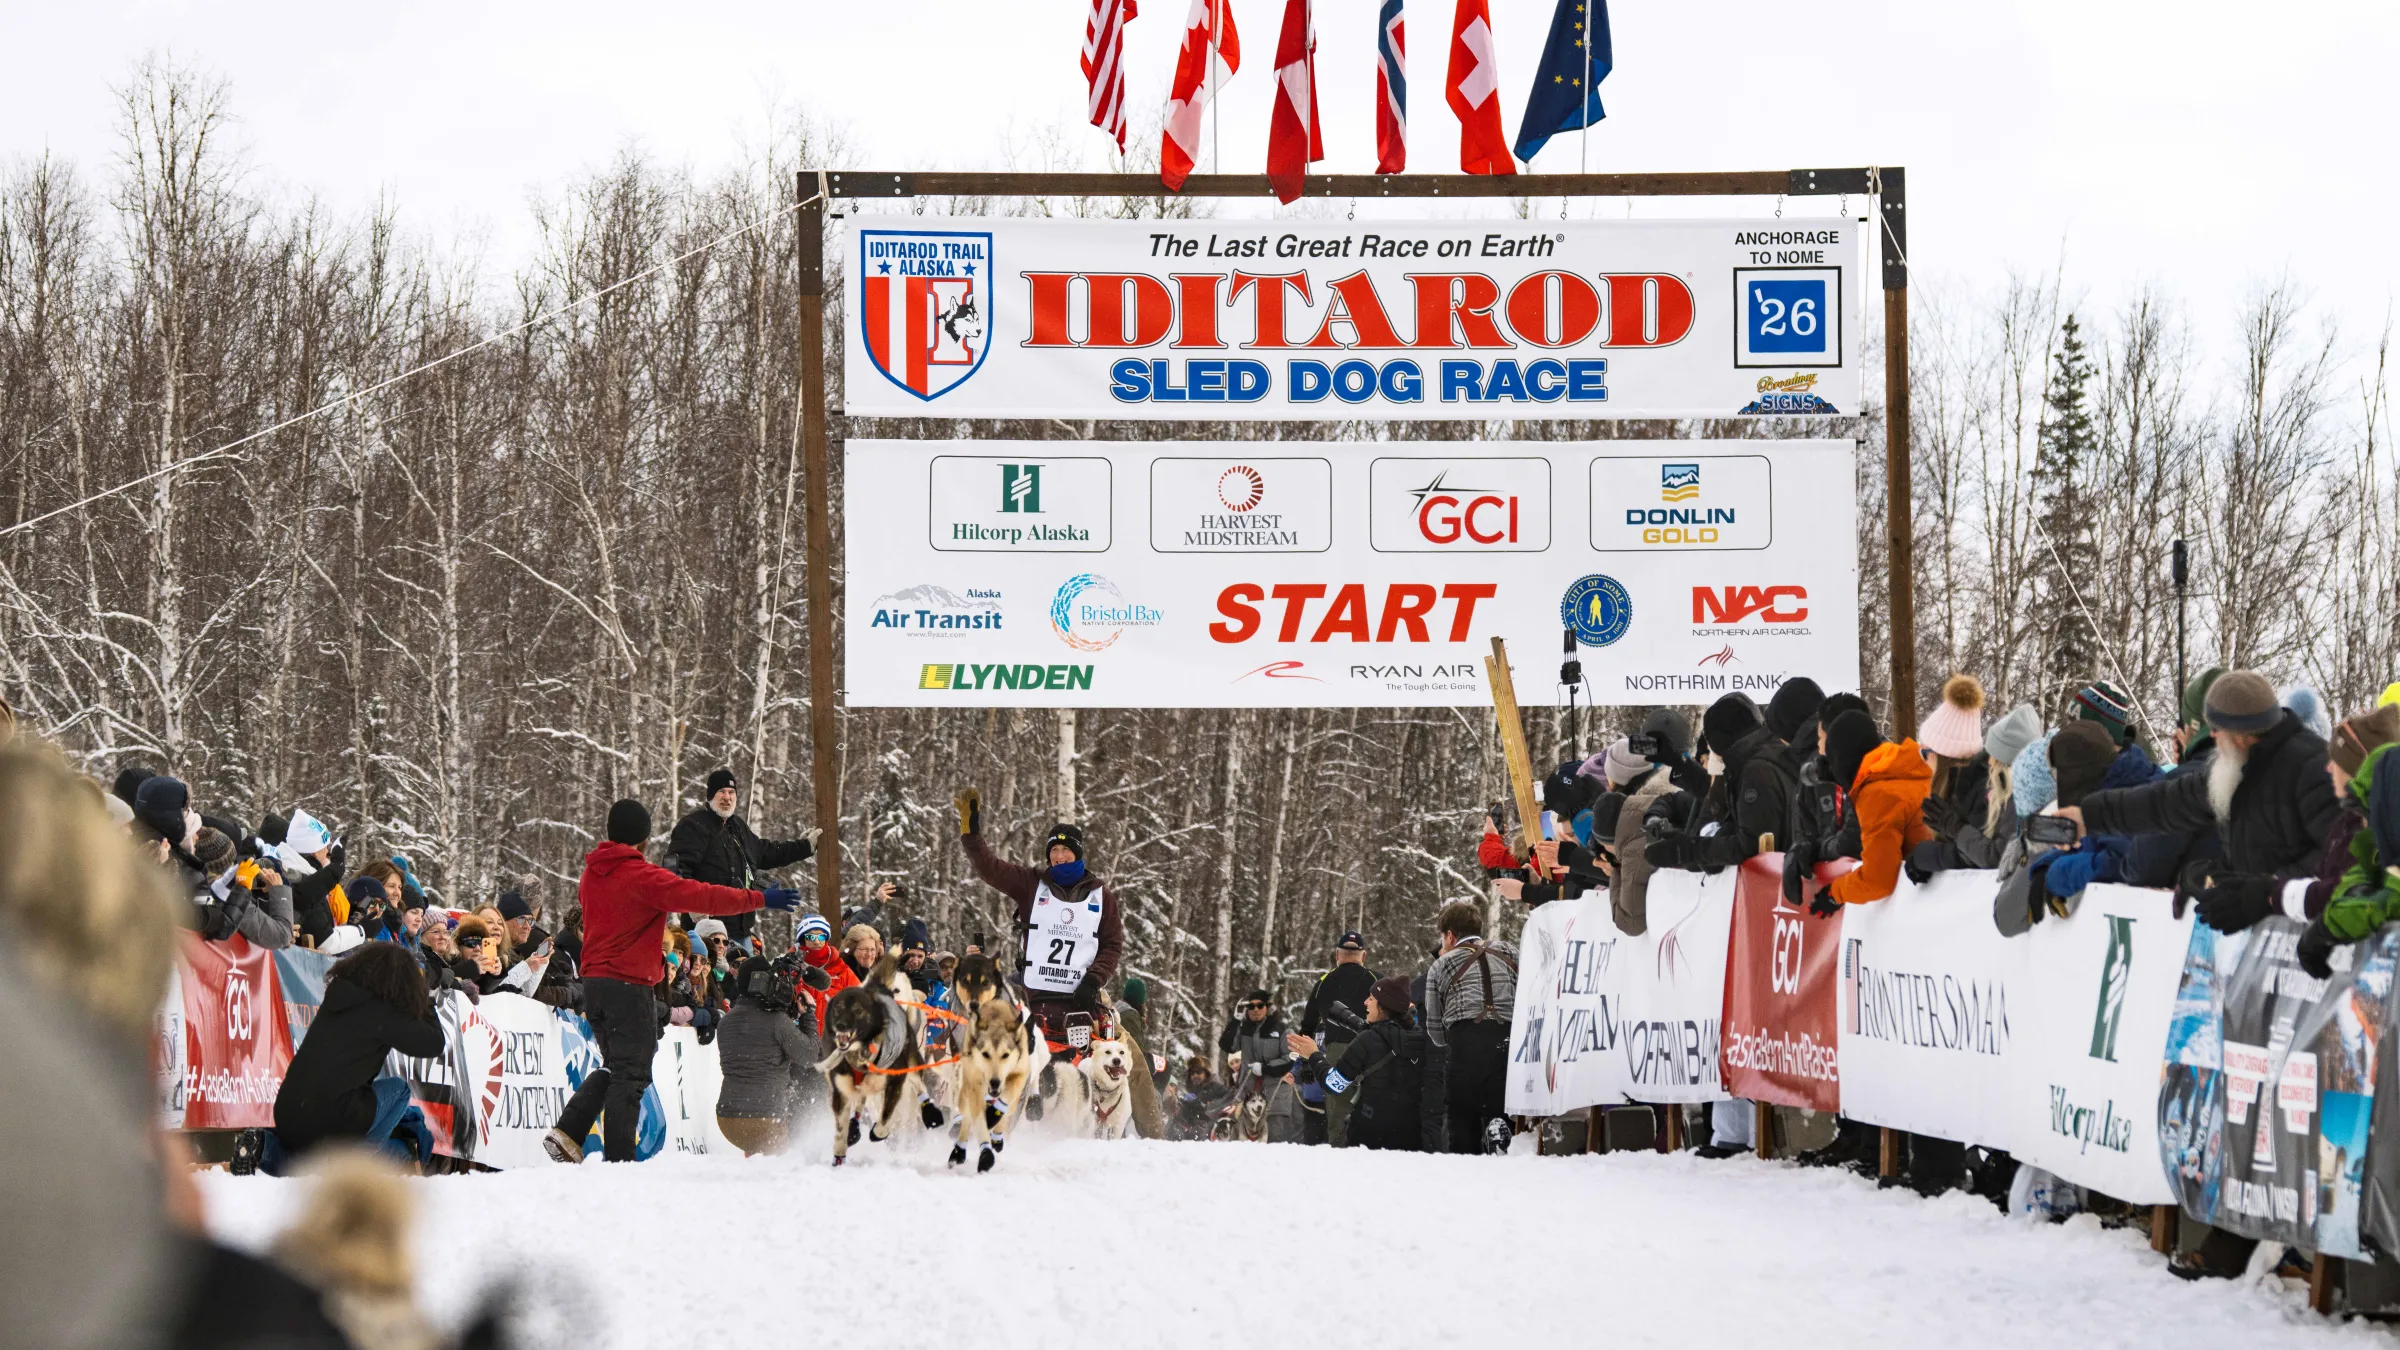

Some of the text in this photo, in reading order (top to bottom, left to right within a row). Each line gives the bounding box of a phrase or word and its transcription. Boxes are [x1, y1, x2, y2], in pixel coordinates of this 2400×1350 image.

[1150, 234, 1198, 257] The
[1207, 234, 1268, 257] Last
[1276, 234, 1352, 257] Great
[1359, 235, 1428, 257] Race
[1437, 240, 1471, 257] on
[1735, 231, 1839, 245] ANCHORAGE
[869, 241, 985, 261] IDITAROD TRAIL
[1750, 251, 1824, 264] TO NOME
[899, 259, 956, 277] ALASKA
[1020, 269, 1696, 350] IDITAROD
[1110, 356, 1609, 405] SLED DOG RACE
[1760, 392, 1816, 411] SIGNS
[1202, 515, 1281, 528] HARVEST
[1418, 496, 1519, 545] GCI
[1627, 508, 1735, 525] DONLIN
[953, 524, 1089, 544] Hilcorp Alaska
[1185, 532, 1297, 545] MIDSTREAM
[1643, 528, 1718, 543] GOLD
[967, 589, 1001, 598] Alaska
[1568, 579, 1624, 604] CITY OF NOME
[1208, 581, 1498, 644] START
[1692, 586, 1808, 623] NAC
[871, 610, 1002, 629] Air Transit
[1081, 604, 1165, 626] Bristol Bay
[905, 630, 968, 640] www.flyaat.com
[1582, 633, 1604, 642] APRIL
[953, 663, 1095, 690] LYNDEN
[1351, 665, 1475, 678] RYAN AIR
[1386, 683, 1402, 691] The
[1404, 682, 1430, 692] Tough
[1450, 682, 1476, 691] Going
[1626, 673, 1783, 691] NORTHRIM BANK
[1047, 929, 1084, 940] MIDSTREAM
[1053, 923, 1079, 933] HARVEST
[1047, 938, 1076, 966] 27
[1772, 915, 1803, 996] GCI
[1038, 965, 1069, 979] IDITAROD
[1331, 1080, 1345, 1091] 20
